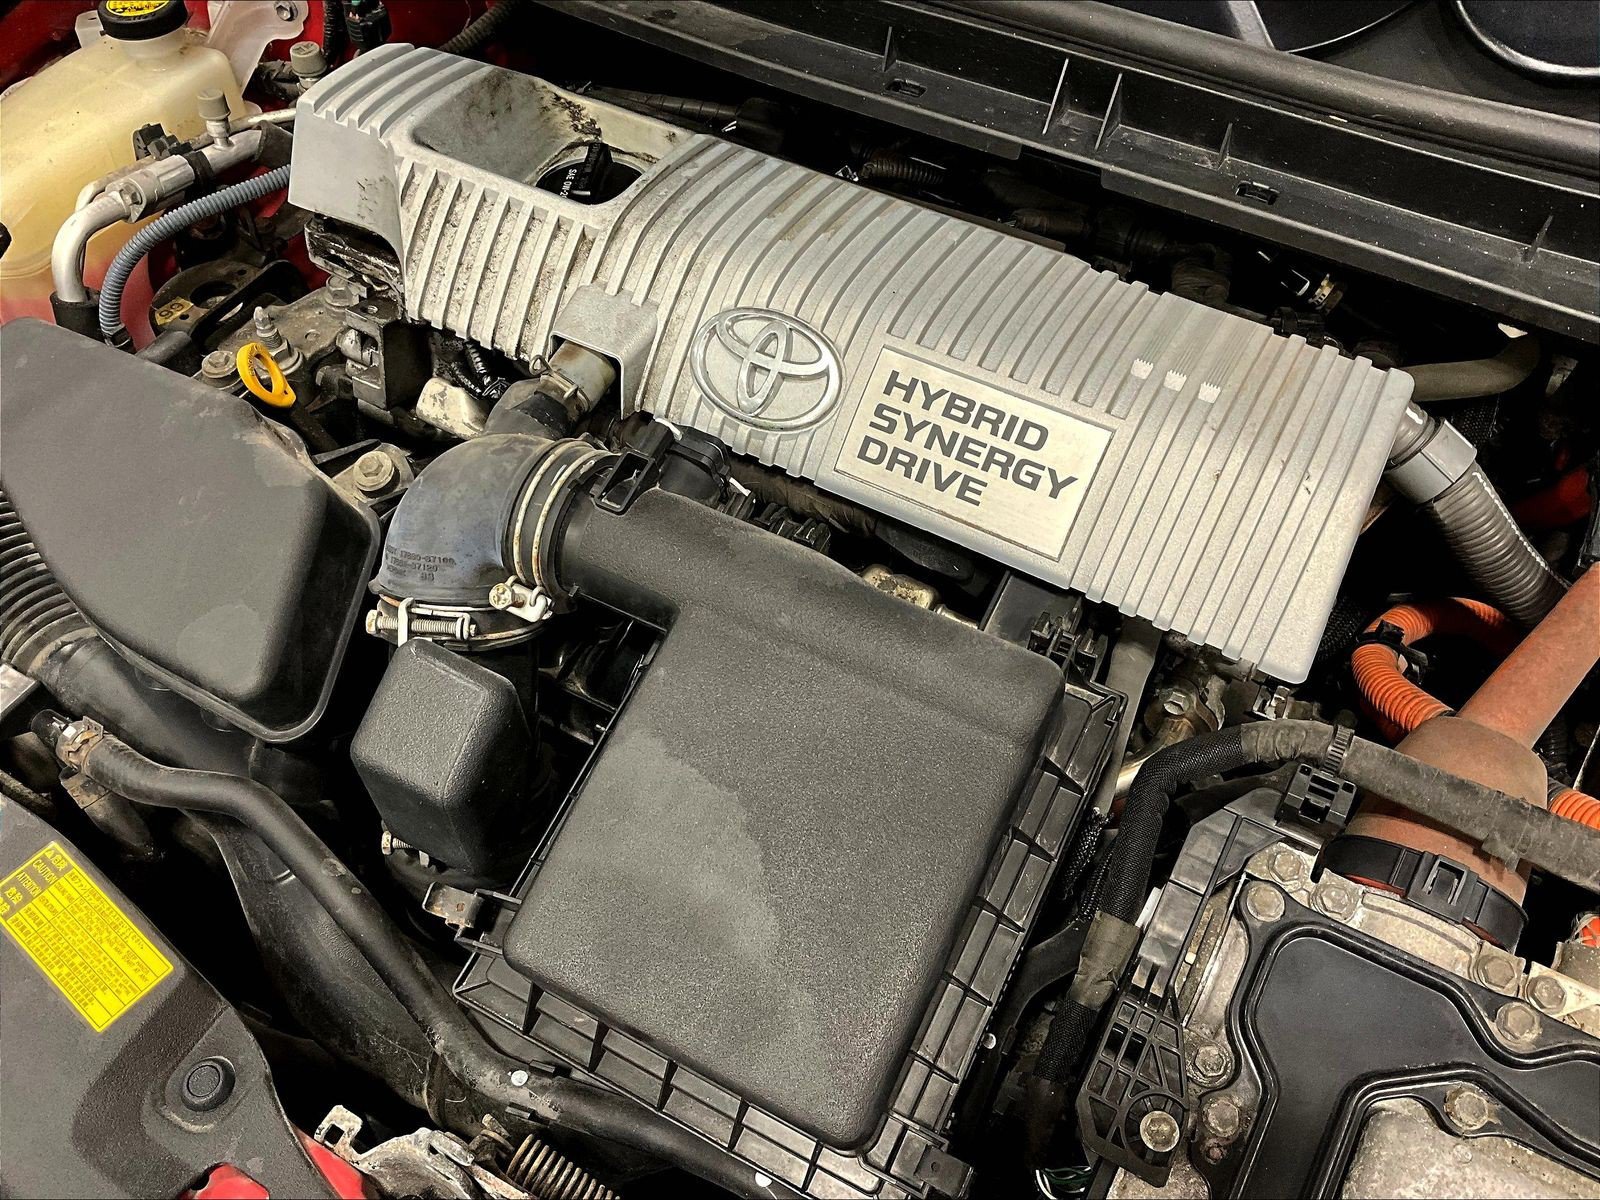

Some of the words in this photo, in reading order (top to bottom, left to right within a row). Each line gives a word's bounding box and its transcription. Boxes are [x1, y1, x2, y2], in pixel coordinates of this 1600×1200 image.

[566, 168, 577, 180] SAE
[882, 369, 1049, 452] HYBRID
[856, 434, 989, 507] DRIVE
[868, 402, 1079, 500] SYNERGY
[16, 871, 42, 898] ATTENTION
[32, 859, 58, 885] CAUTION
